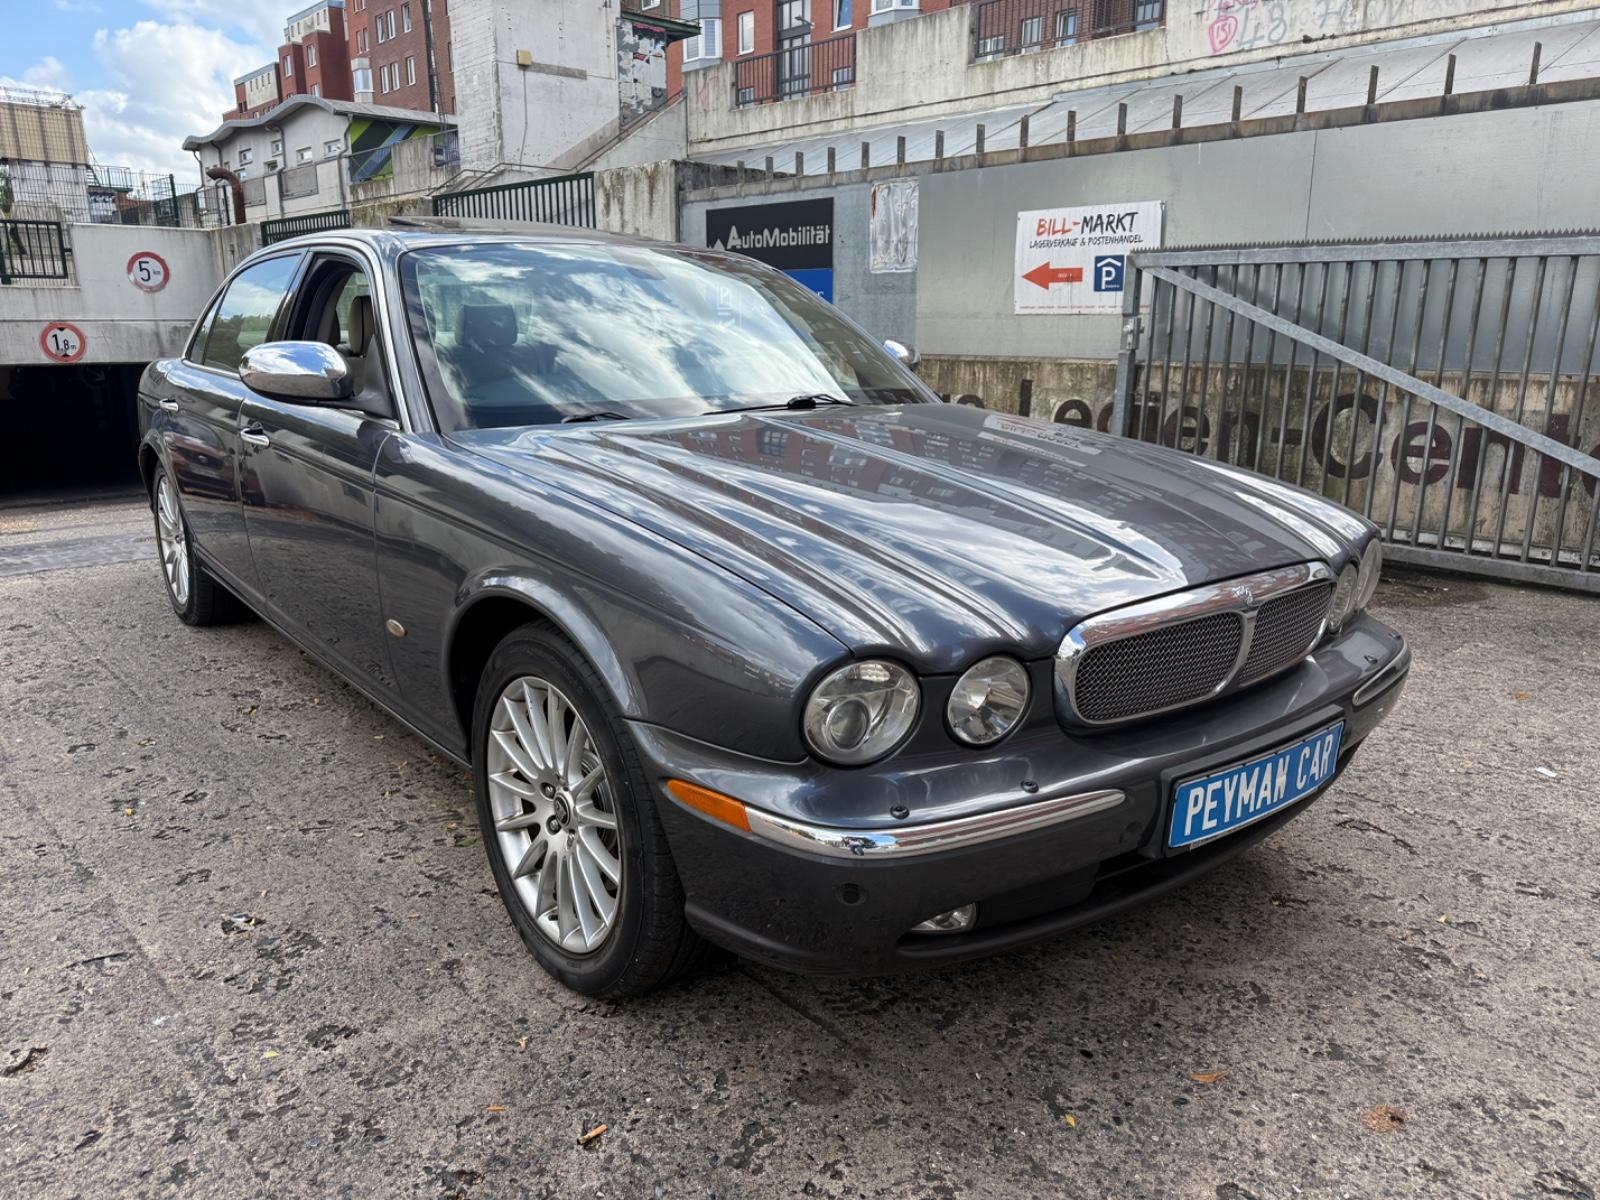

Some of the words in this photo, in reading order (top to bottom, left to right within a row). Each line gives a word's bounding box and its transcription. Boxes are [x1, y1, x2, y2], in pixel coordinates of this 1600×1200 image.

[1036, 212, 1138, 236] BILL-MARKT
[727, 225, 830, 249] AutoMobilität
[1088, 234, 1143, 247] POSTENHANDEL
[138, 260, 151, 282] 5
[1101, 266, 1116, 290] P
[1184, 755, 1290, 836] PEYMAN
[1296, 734, 1333, 790] CAR
